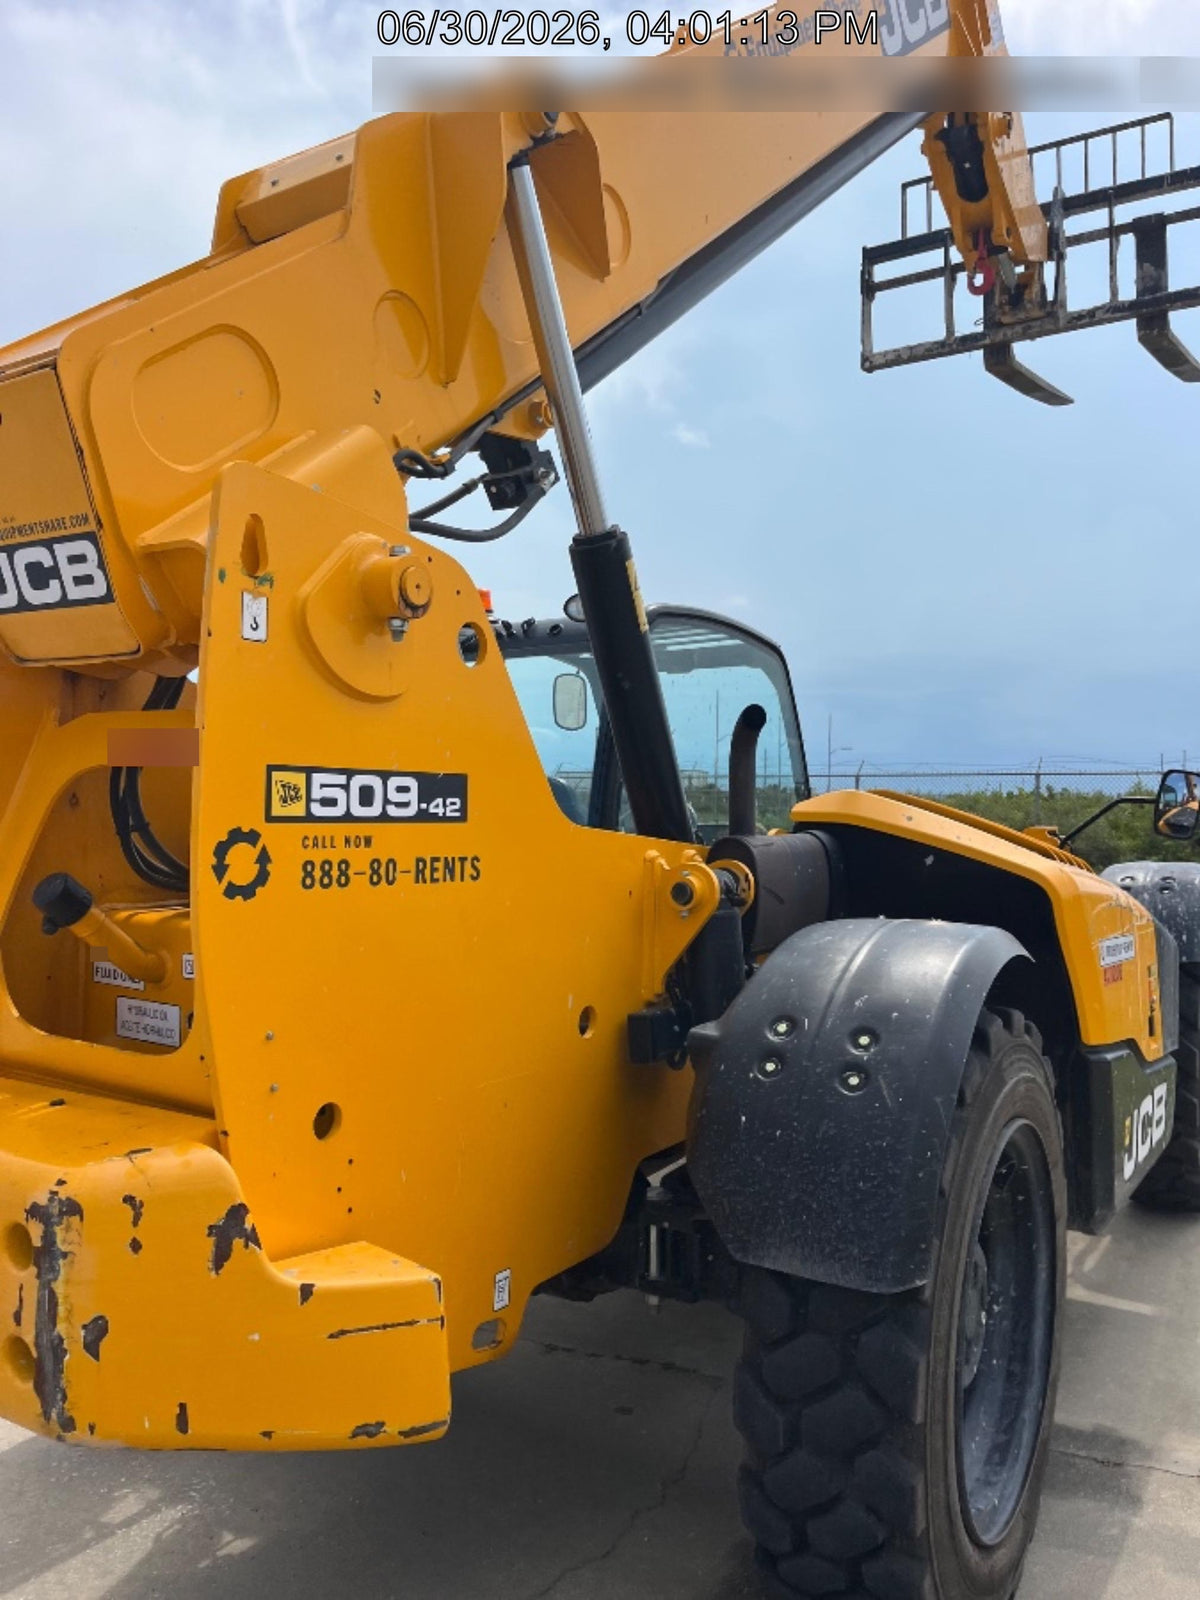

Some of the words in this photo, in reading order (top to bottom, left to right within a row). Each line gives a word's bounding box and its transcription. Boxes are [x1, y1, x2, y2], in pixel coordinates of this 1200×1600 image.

[0, 512, 89, 541] QUIPMENTSHARE.COM
[0, 540, 107, 609] JCB
[310, 773, 461, 817] 509-42
[302, 836, 336, 848] CALL
[344, 836, 373, 848] NOW
[301, 856, 481, 889] 888-80-RENTS
[1123, 1082, 1167, 1181] JCB
